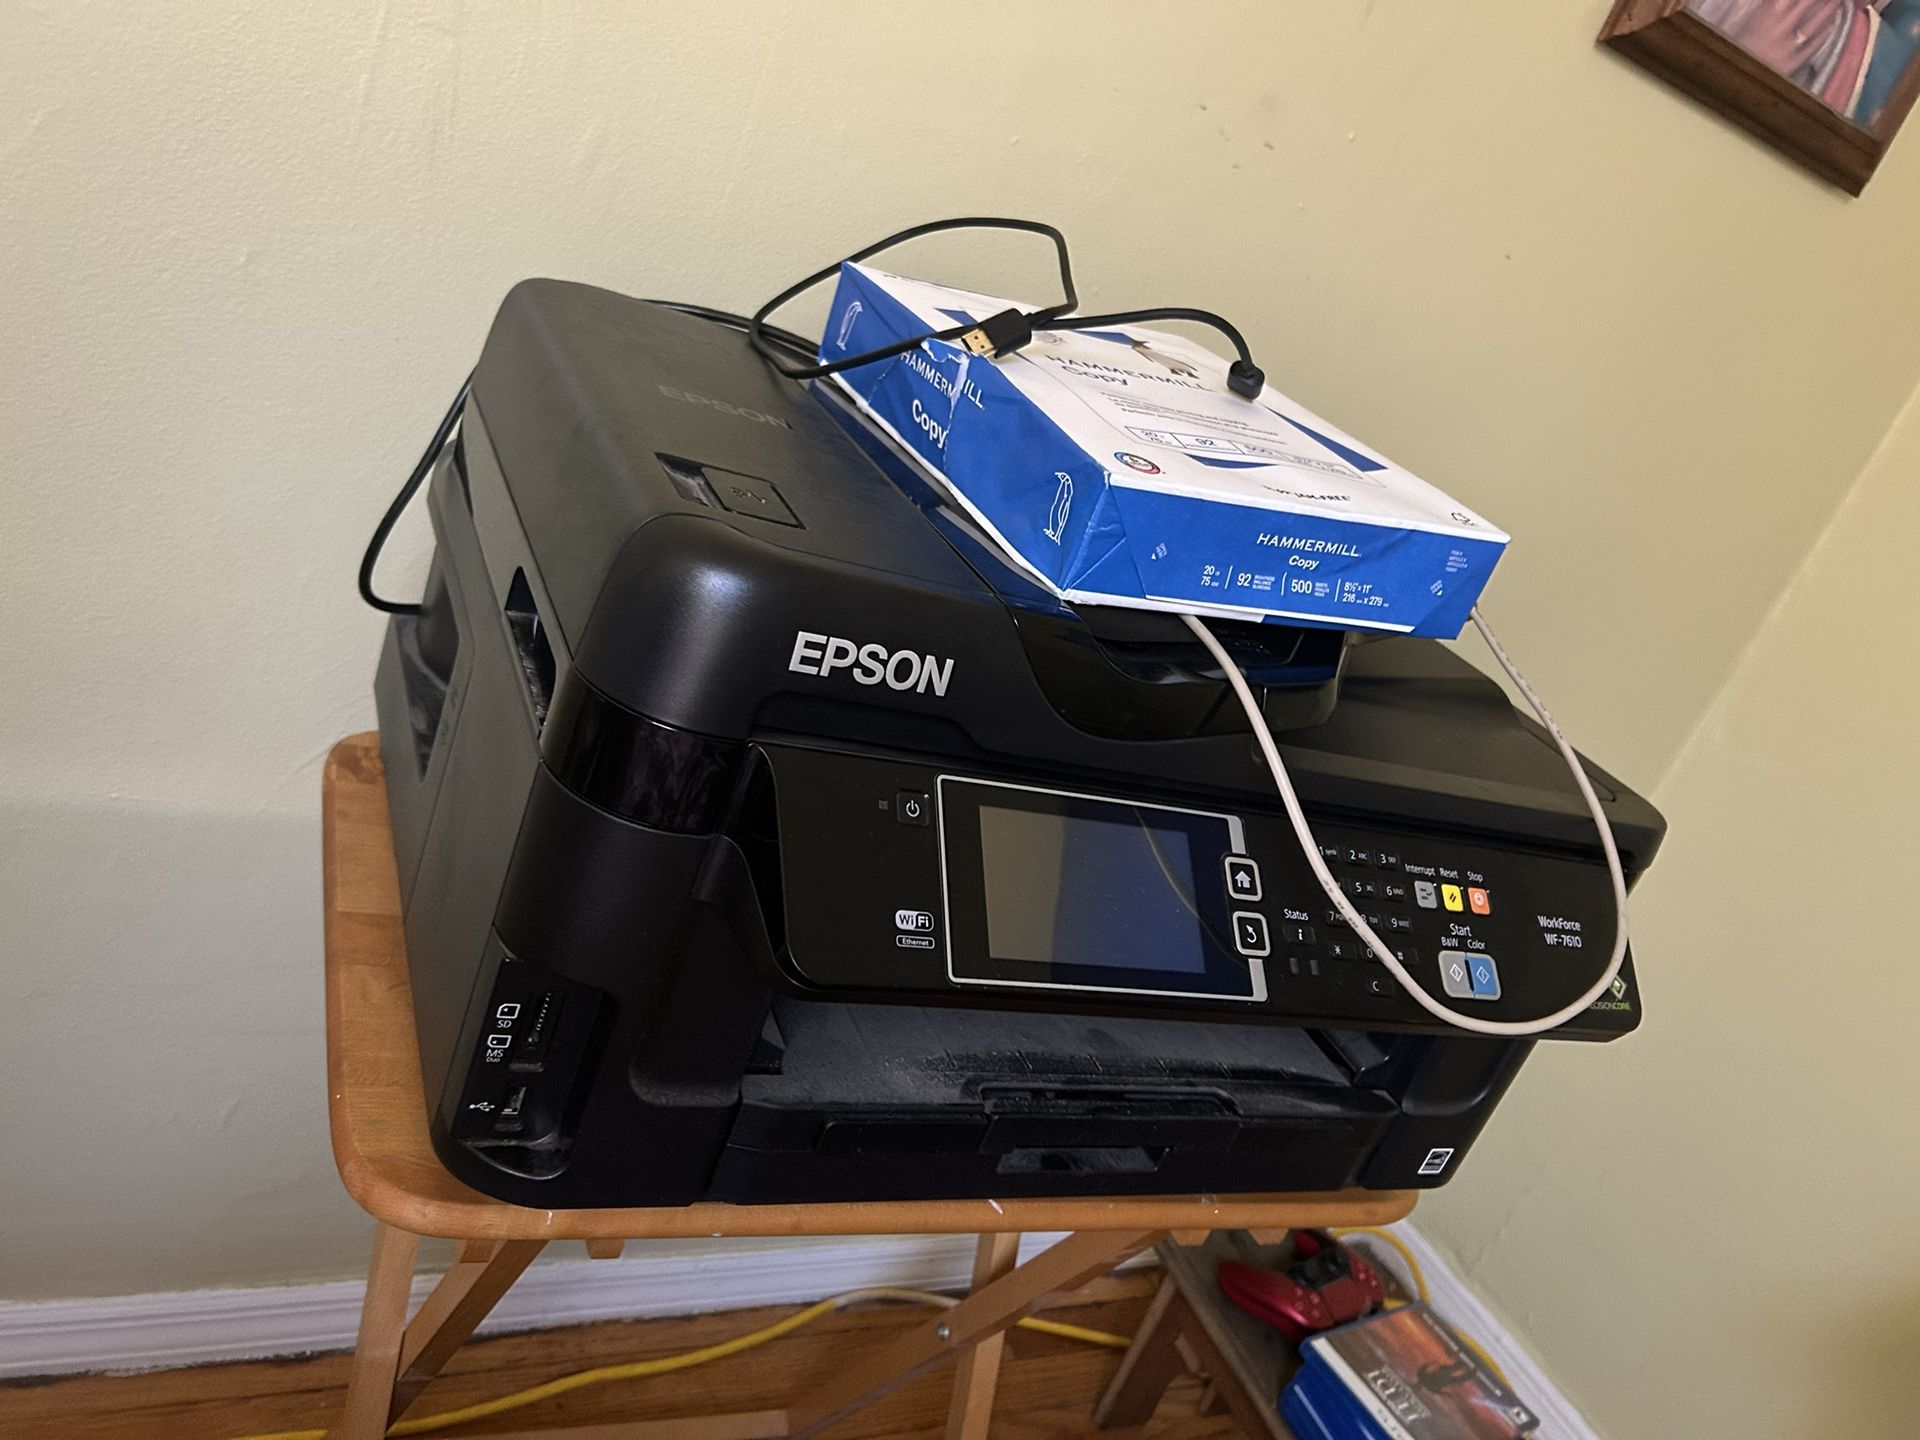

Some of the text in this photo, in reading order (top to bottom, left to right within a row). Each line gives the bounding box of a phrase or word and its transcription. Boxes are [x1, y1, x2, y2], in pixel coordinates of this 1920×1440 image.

[900, 350, 984, 409] HAMMERMILL
[658, 385, 794, 430] EPSON
[912, 399, 948, 449] Copy
[1256, 533, 1360, 557] HAMMERMILL
[1288, 555, 1320, 571] Copy
[1203, 565, 1215, 576] 20
[1201, 576, 1211, 586] 75
[1237, 573, 1252, 587] 92
[1291, 579, 1313, 594] 500
[1342, 593, 1356, 604] 216
[1368, 596, 1383, 607] 279
[788, 630, 955, 697] EPSON
[1349, 849, 1356, 860] 2
[1380, 853, 1387, 864] 3
[1405, 863, 1436, 877] Interrupt
[1440, 867, 1459, 879] Reset
[1467, 871, 1484, 883] Stop
[1355, 882, 1362, 893] 5
[1386, 886, 1393, 896] 6
[1284, 909, 1309, 922] Status
[1329, 911, 1335, 921] 7
[1391, 917, 1398, 928] 9
[1537, 915, 1581, 931] WorkForce
[1450, 923, 1472, 937] Start
[902, 938, 929, 946] Ethernet
[1441, 936, 1459, 948] B&W
[1467, 939, 1486, 950] Color
[1544, 933, 1582, 948] WF-7610
[497, 1020, 512, 1028] SD
[487, 1049, 504, 1058] MS
